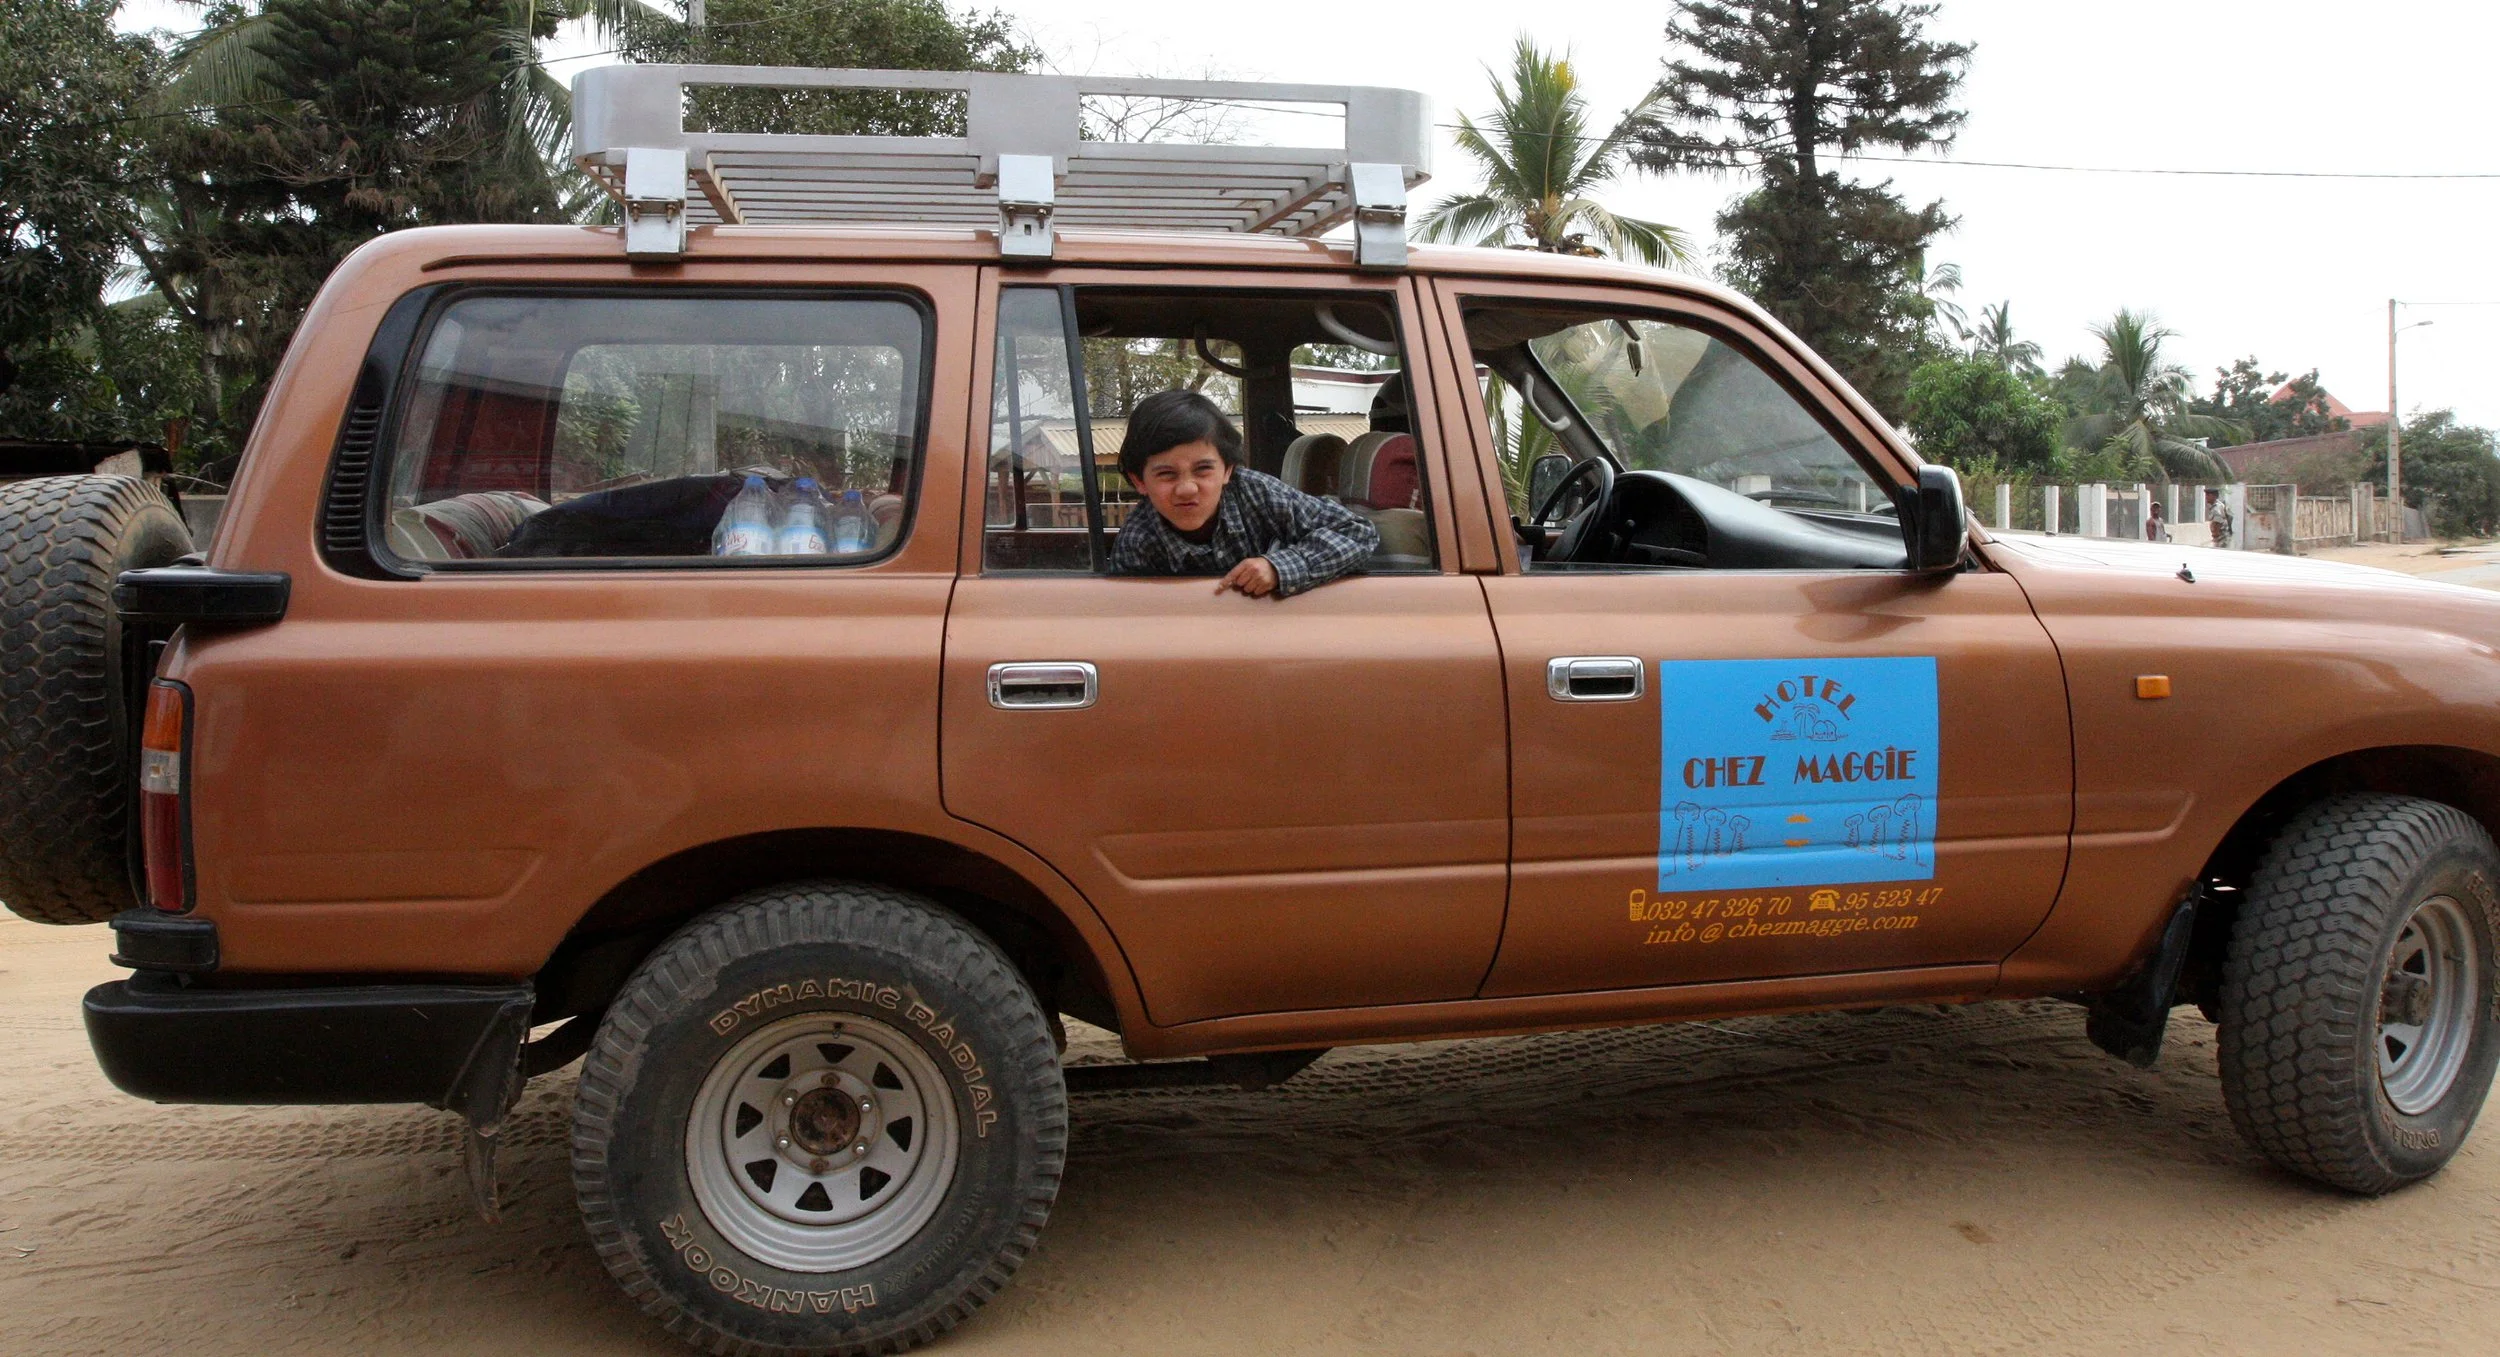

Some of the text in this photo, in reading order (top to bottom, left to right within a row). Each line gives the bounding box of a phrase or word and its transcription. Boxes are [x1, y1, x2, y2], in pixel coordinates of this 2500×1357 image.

[1754, 675, 1856, 723] HOTEL
[1683, 756, 1766, 788] CHEZ
[1691, 899, 1719, 919] 47
[1721, 897, 1762, 918] 326
[1767, 896, 1792, 916] 70
[1872, 888, 1912, 909] 523
[1915, 887, 1943, 905] 47
[709, 978, 998, 1138] DYNAMIC RADIAL
[660, 1213, 877, 1313] HANKOOK
